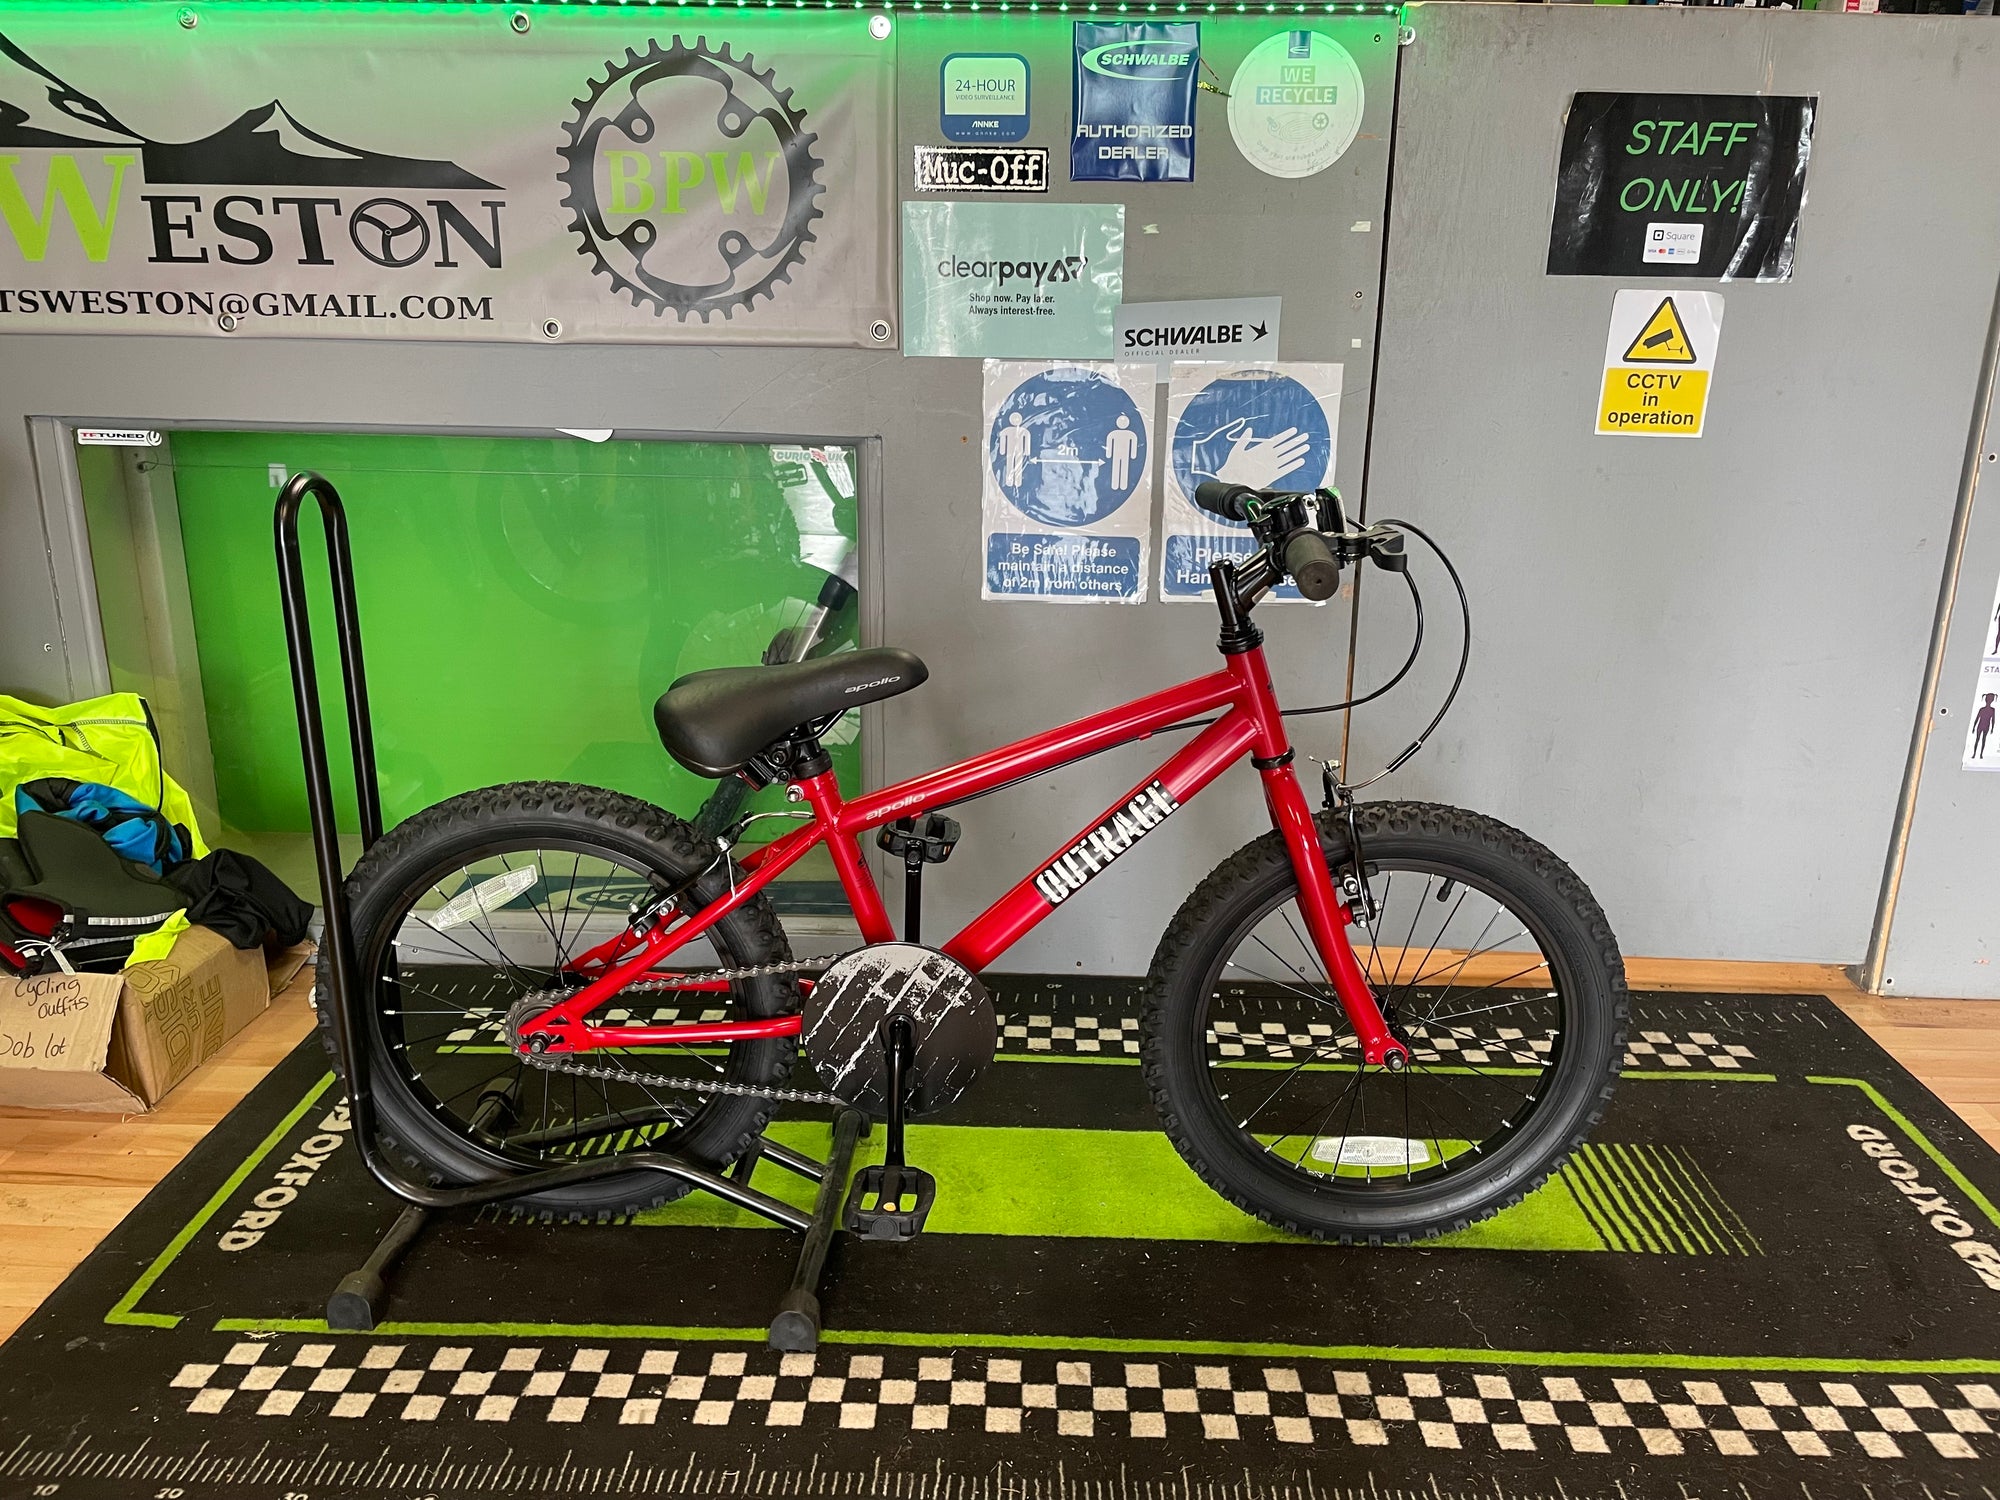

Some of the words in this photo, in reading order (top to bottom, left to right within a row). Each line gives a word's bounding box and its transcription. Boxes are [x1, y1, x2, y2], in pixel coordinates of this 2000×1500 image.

[1101, 53, 1190, 66] SCHWALBE
[1284, 67, 1312, 82] WE
[955, 79, 1016, 91] 24-HOUR
[1260, 87, 1334, 103] RECYCLE
[971, 120, 999, 128] ANNKE
[1077, 125, 1193, 138] AUTHORIZED
[1626, 120, 1757, 156] STAFF
[1098, 146, 1169, 160] DEALER
[924, 155, 1041, 185] Muc-Off
[603, 151, 780, 215] BPW
[1620, 177, 1746, 214] ONLY!
[1666, 231, 1696, 242] Square
[938, 254, 1049, 288] clearpay
[969, 293, 991, 304] Shop
[993, 294, 1013, 303] now.
[1016, 293, 1031, 305] Pay
[968, 305, 998, 316] Always
[1000, 305, 1056, 316] interest-free.
[1124, 324, 1243, 348] SCHWALBE
[1627, 373, 1682, 390] CCTV
[1642, 392, 1658, 406] in
[1608, 410, 1694, 427] operation
[827, 452, 845, 461] UK
[1057, 445, 1079, 456] 2m
[1012, 543, 1030, 555] Be
[1071, 544, 1117, 557] Please
[1059, 564, 1067, 573] a
[1071, 562, 1129, 575] distance
[1003, 577, 1016, 588] of
[1020, 577, 1040, 588] 2m
[1079, 578, 1123, 591] others
[844, 675, 901, 693] apollo
[866, 793, 926, 820] apollo
[1035, 780, 1180, 904] OUTRAGE
[15, 978, 81, 1006] Cycling
[44, 1032, 67, 1059] lot
[1846, 1124, 1974, 1238] OXFORD
[218, 1133, 343, 1251] OXFORD
[32, 1484, 60, 1497] 10
[154, 1487, 185, 1500] 20
